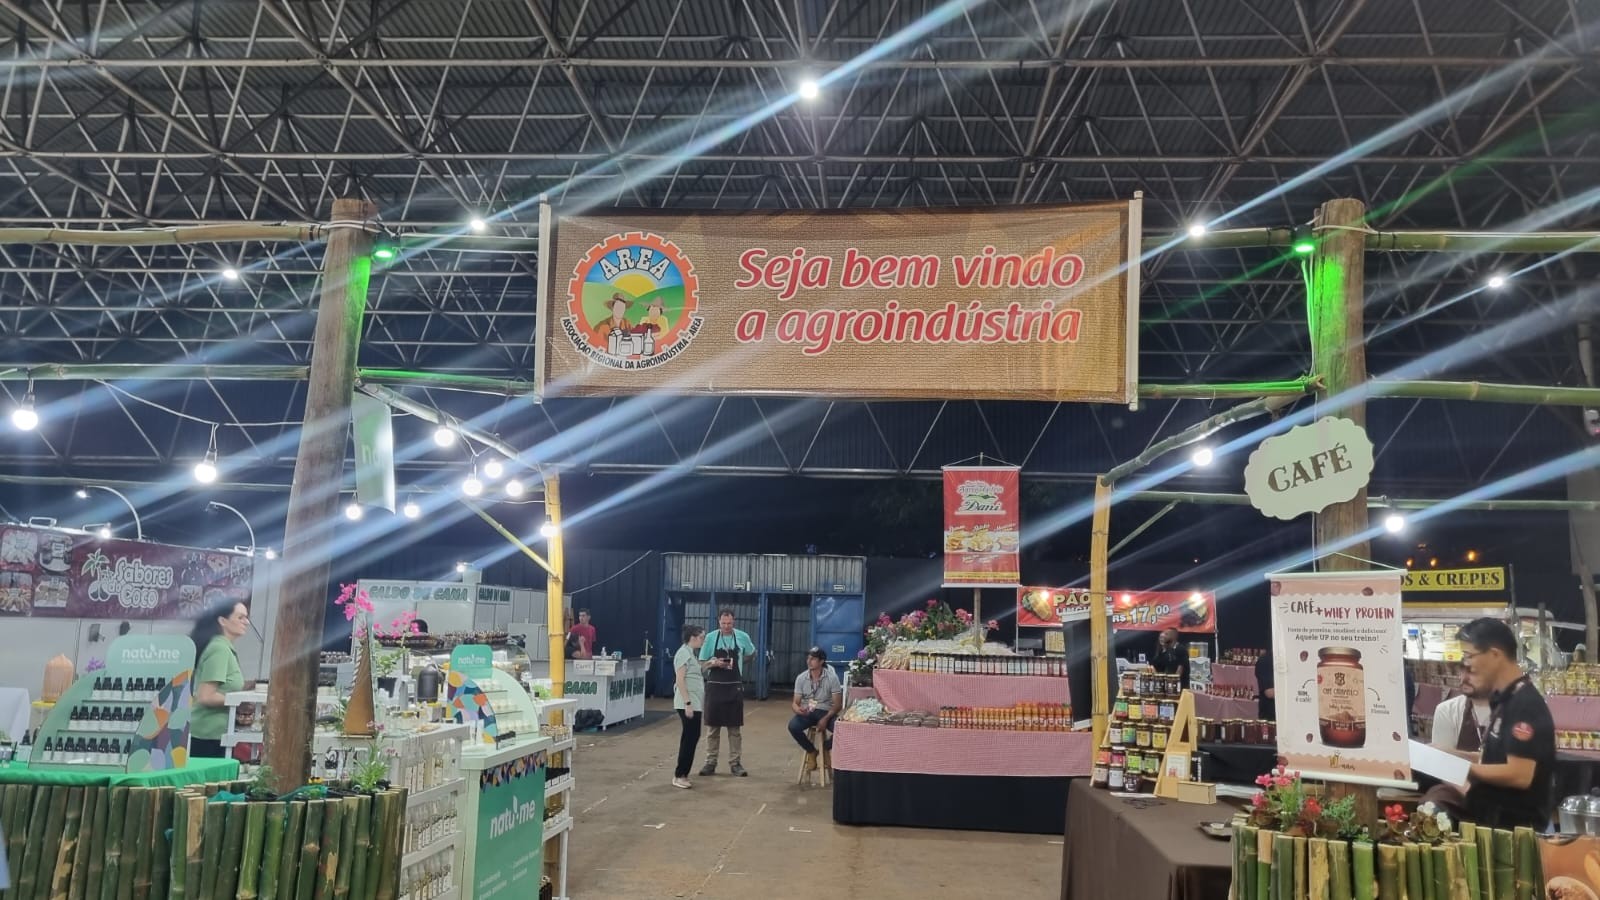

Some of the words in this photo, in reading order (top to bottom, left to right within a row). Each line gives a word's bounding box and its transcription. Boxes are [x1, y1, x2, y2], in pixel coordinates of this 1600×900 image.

[599, 247, 671, 280] AREA
[735, 247, 832, 300] Seja
[840, 248, 940, 288] bem
[953, 245, 1083, 288] vindo
[735, 309, 768, 342] a
[776, 300, 1082, 355] agroindústria
[590, 351, 623, 369] REGIONAL
[625, 361, 635, 369] DA
[690, 318, 703, 336] AREA
[1268, 442, 1352, 492] CAFÉ
[965, 500, 1000, 511] Dani
[116, 558, 172, 586] Sabores
[1420, 573, 1430, 586] &
[1436, 571, 1500, 586] CREPES
[120, 583, 158, 608] Coco
[1291, 598, 1314, 614] CAFÉ
[1324, 607, 1351, 619] WHEY
[1356, 607, 1394, 619] PROTEIN
[1296, 634, 1318, 642] Aquele
[564, 681, 597, 695] CANA
